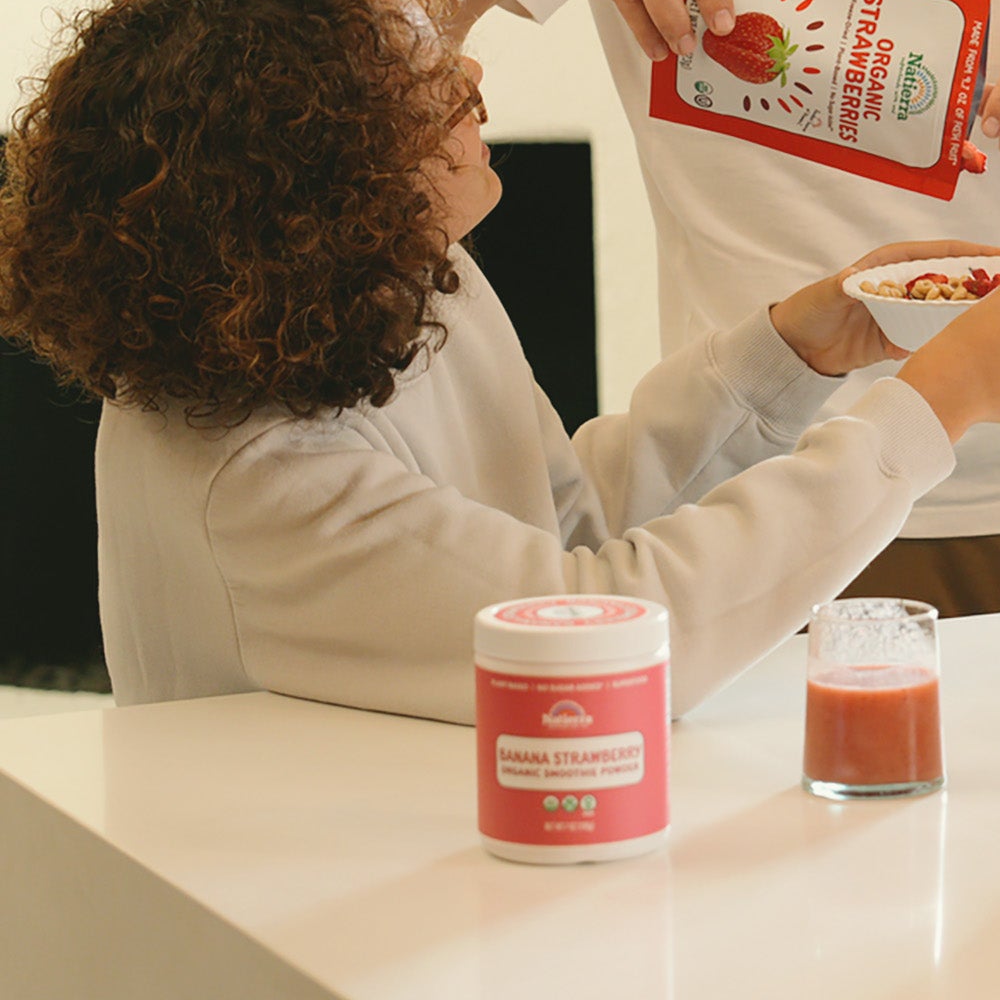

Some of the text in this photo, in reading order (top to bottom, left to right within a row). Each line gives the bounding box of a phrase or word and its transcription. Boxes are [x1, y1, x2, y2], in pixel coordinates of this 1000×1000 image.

[969, 20, 982, 45] MADE
[964, 48, 978, 74] FROM
[863, 37, 894, 121] ORGANIC
[897, 52, 923, 121] Natierra
[957, 91, 968, 104] OZ
[500, 747, 640, 765] BANANA STRAWBERRY
